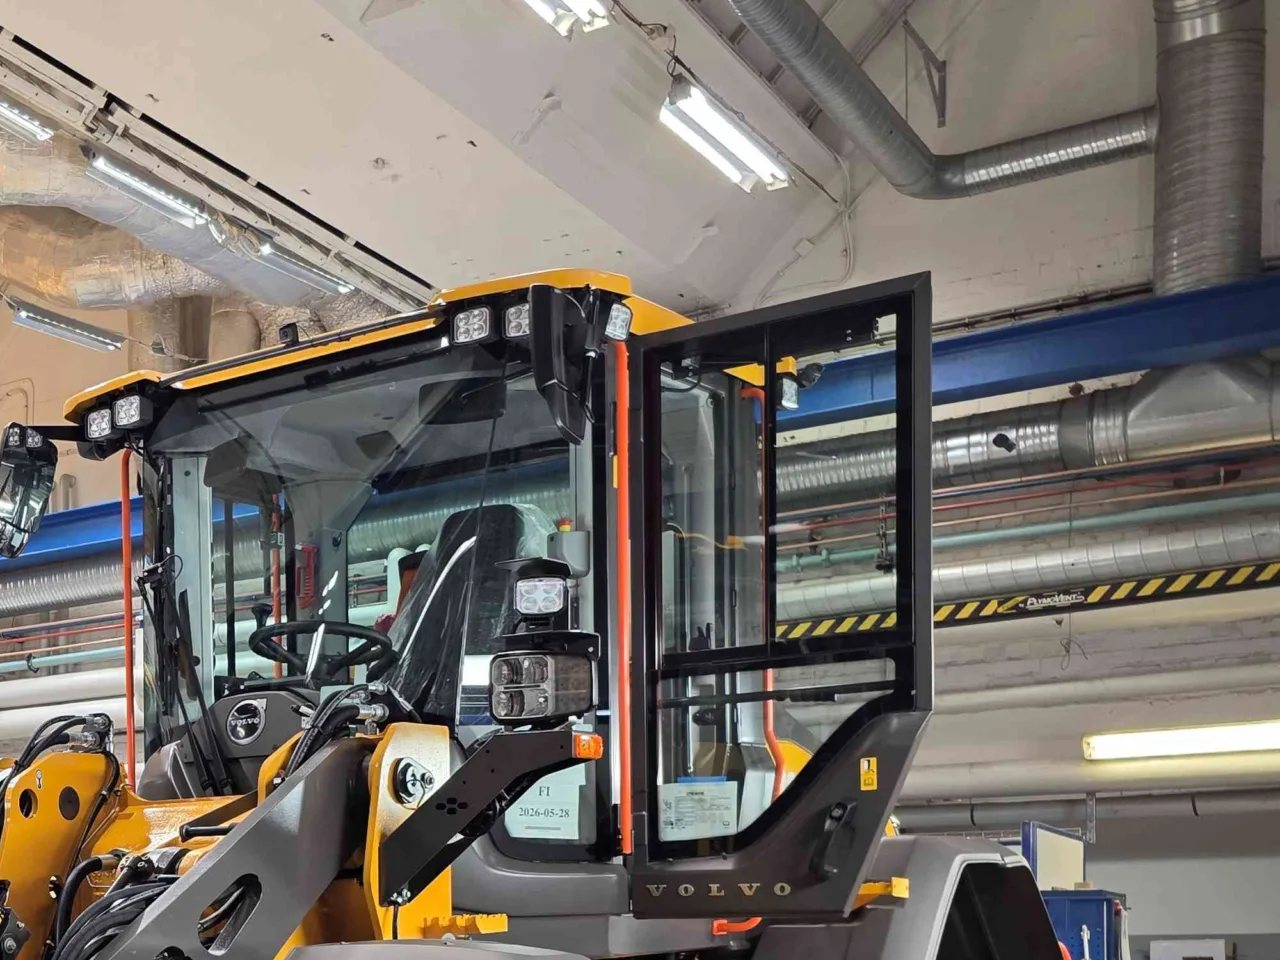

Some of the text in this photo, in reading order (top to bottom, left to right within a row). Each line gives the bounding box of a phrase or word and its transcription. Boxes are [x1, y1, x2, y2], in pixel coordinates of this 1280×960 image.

[231, 717, 260, 727] VOLVO
[538, 785, 551, 797] FI
[518, 807, 571, 818] 2026-05-28
[645, 882, 792, 897] VOLVO
